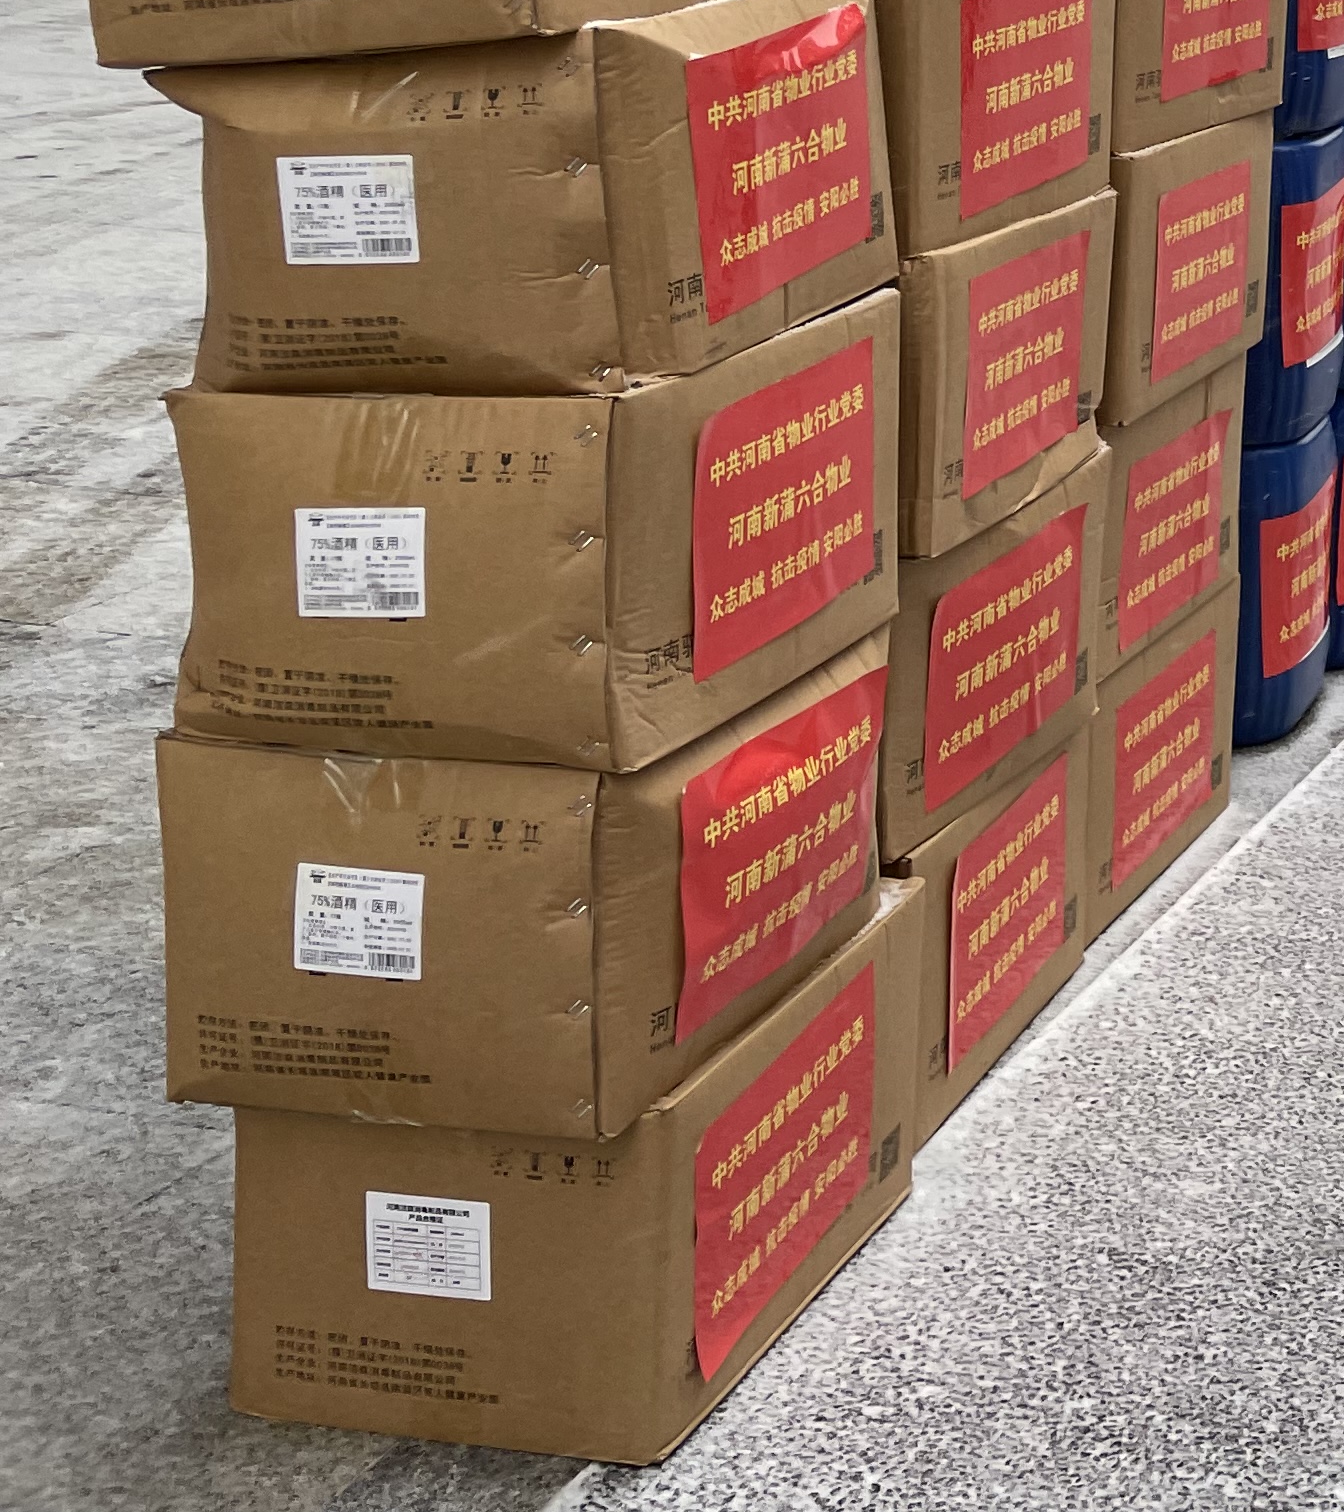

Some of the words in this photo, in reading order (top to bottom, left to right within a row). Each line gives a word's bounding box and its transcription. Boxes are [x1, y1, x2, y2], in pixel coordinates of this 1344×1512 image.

[973, 0, 1084, 58] 中共河南省物业行业党委
[708, 50, 857, 130] 中共河南省物业行业党委
[986, 57, 1073, 113] 河南新蒲六合物业
[733, 118, 846, 194] 河南新蒲六合物业
[720, 221, 768, 265] 众志成城
[772, 199, 814, 240] 抗击疫情
[820, 177, 859, 216] 安阳必胜
[1165, 193, 1244, 244] 中共河南省物业行业党委
[979, 269, 1078, 334] 中共河南省物业行业党委
[1172, 243, 1234, 291] 河南新蒲六合物业
[985, 328, 1064, 390] 河南新蒲六合物业
[711, 384, 863, 486] 中共河南省物业行业党委
[1134, 441, 1220, 514] 中共河南省物业行业党委
[729, 456, 851, 548] 河南新蒲六合物业
[1139, 494, 1210, 555] 河南新蒲六合物业
[711, 571, 765, 622] 众志成城
[771, 540, 819, 588] 抗击疫情
[824, 511, 862, 556] 安阳必胜
[943, 546, 1072, 651] 中共河南省物业行业党委
[956, 607, 1060, 700] 河南新蒲六合物业
[1125, 665, 1209, 750] 中共河南省物业行业党委
[705, 716, 871, 847] 中共河南省物业行业党委
[1133, 718, 1200, 793] 河南新蒲六合物业
[726, 791, 856, 907] 河南新蒲六合物业
[957, 795, 1059, 913] 中共河南省物业行业党委
[703, 924, 758, 980] 众志成城
[763, 882, 812, 937] 抗击疫情
[817, 844, 858, 894] 安阳必胜
[969, 857, 1048, 958] 河南新蒲六合物业
[712, 1016, 863, 1187] 中共河南省物业行业党委
[729, 1093, 848, 1240] 河南新蒲六合物业
[712, 1247, 760, 1315] 众志成城
[766, 1189, 810, 1256] 抗击疫情
[815, 1139, 858, 1199] 安阳必胜
